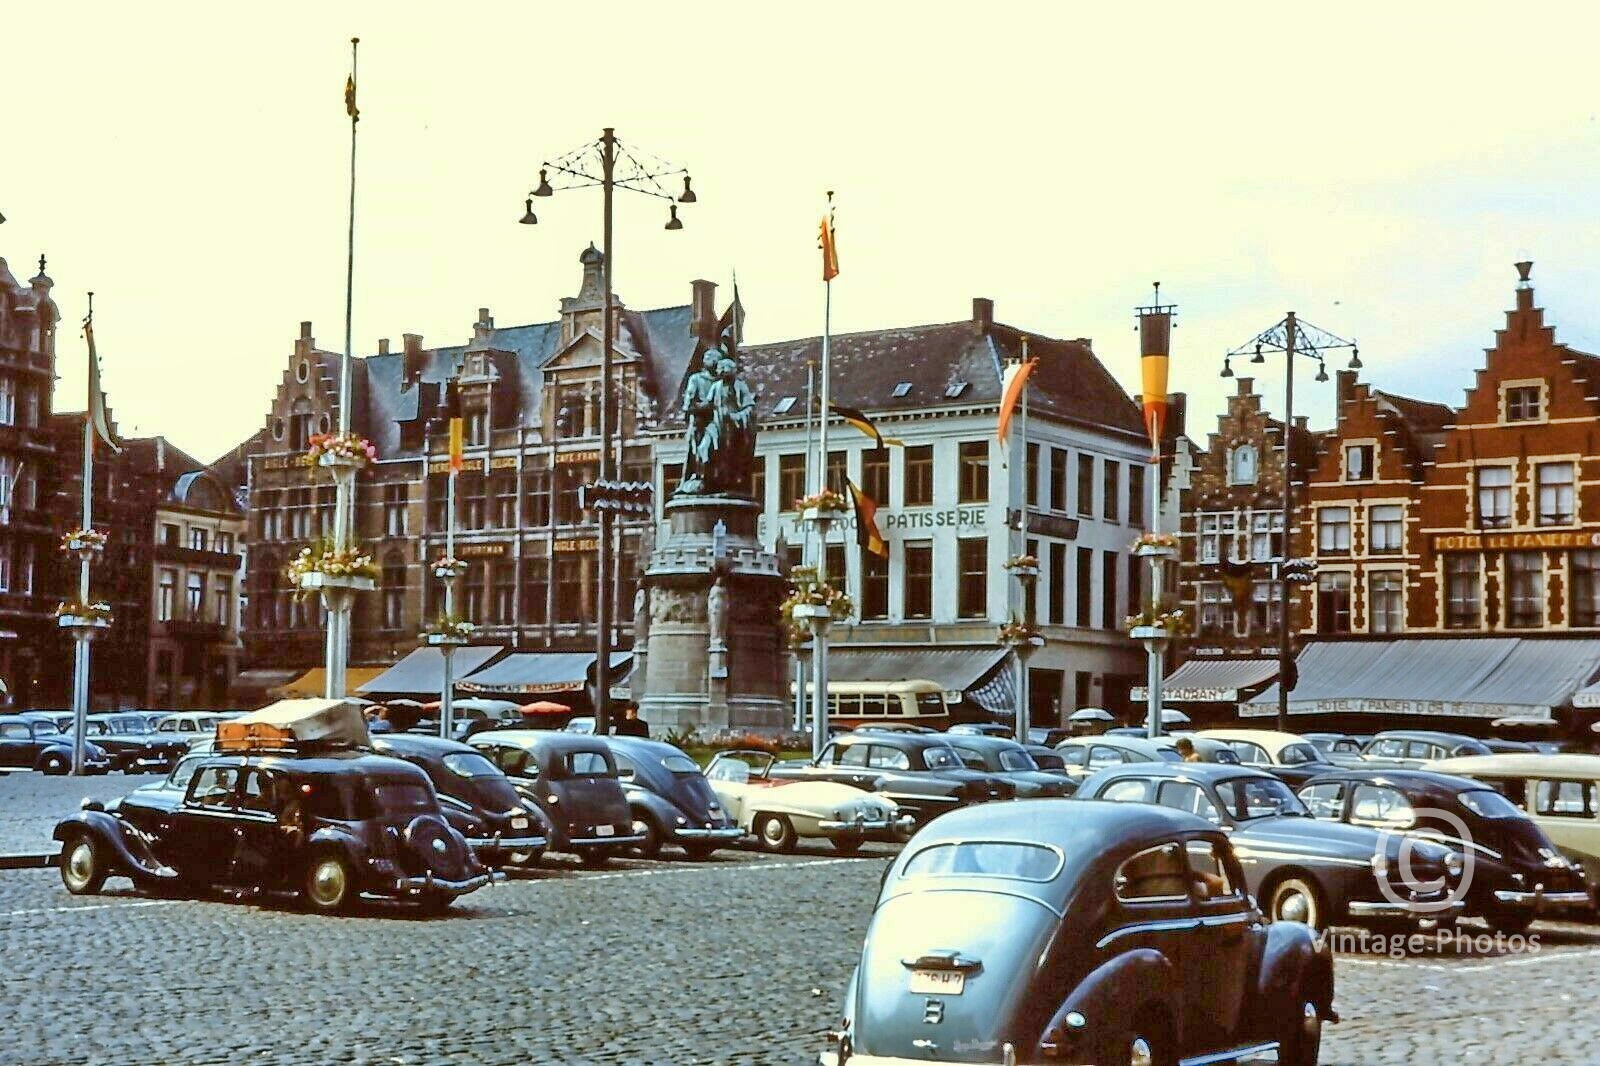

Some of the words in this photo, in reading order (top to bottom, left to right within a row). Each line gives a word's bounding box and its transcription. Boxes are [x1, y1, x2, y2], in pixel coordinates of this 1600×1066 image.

[886, 509, 986, 529] PATISSERIE
[1435, 535, 1483, 549] HOTEL
[1513, 533, 1572, 547] PANIER
[1140, 688, 1224, 700] RSTAURANT
[1317, 701, 1353, 710] HOTEL
[1367, 700, 1412, 711] PANIER
